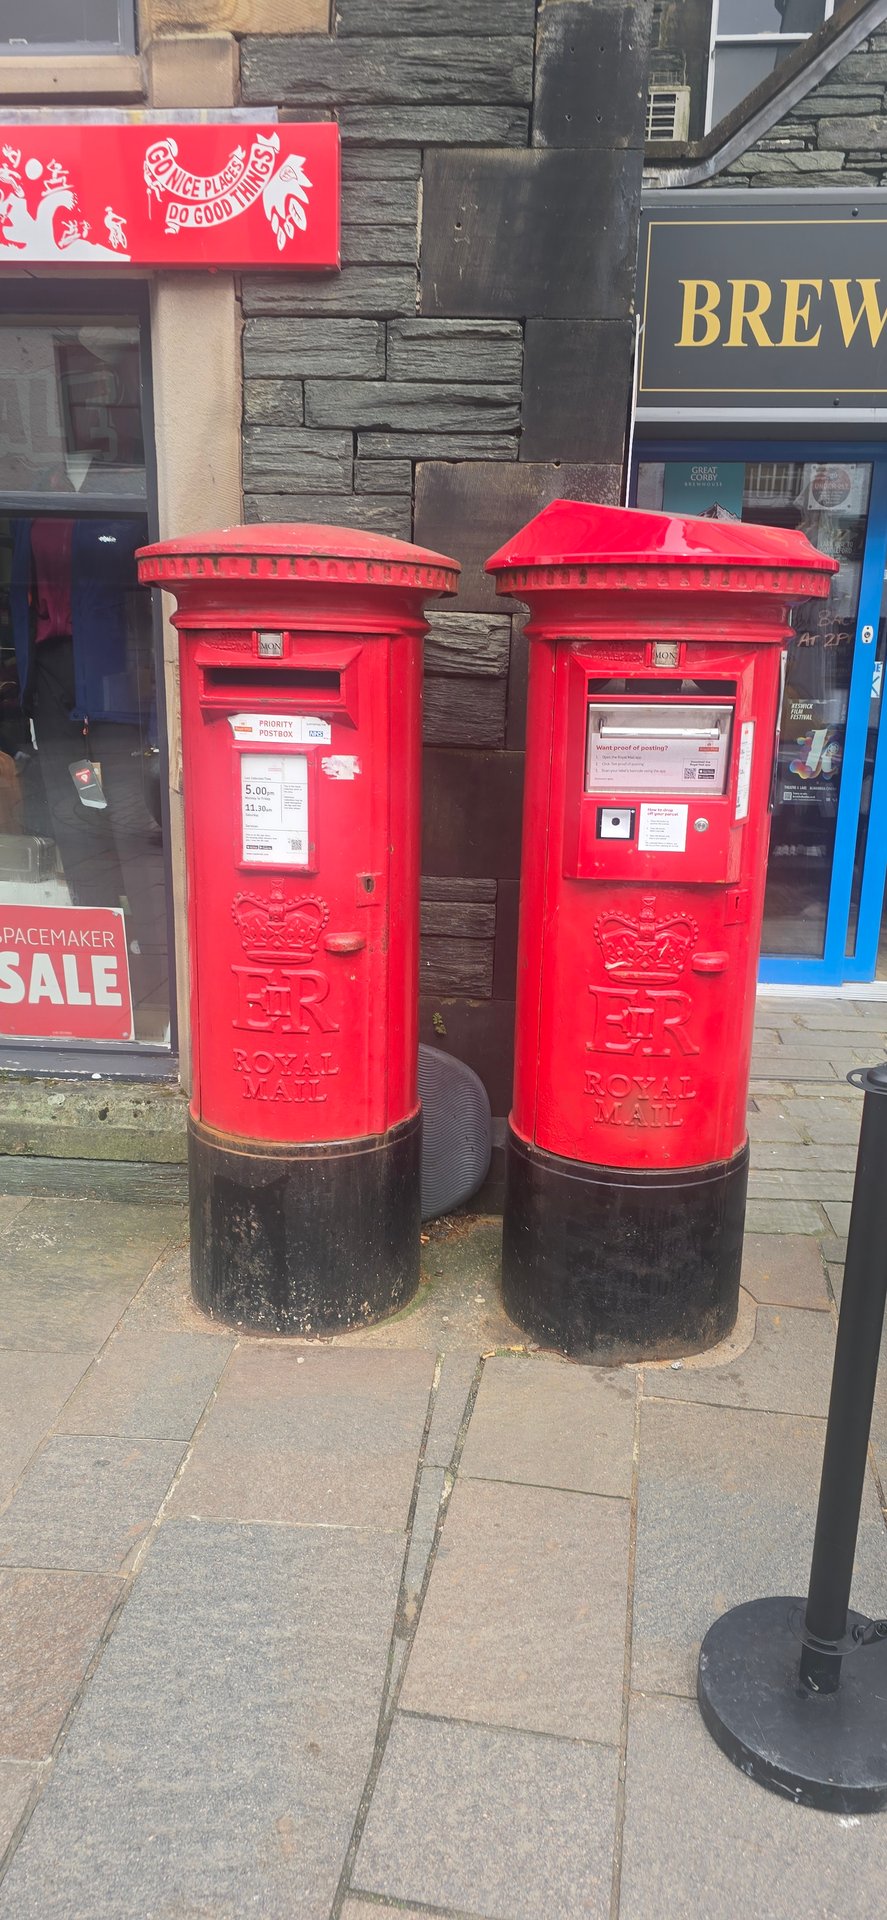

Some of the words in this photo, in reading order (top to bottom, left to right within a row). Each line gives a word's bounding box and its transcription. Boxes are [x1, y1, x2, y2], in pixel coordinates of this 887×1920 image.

[148, 146, 173, 176] GO
[165, 167, 201, 197] NICE
[204, 160, 242, 198] PLACES
[169, 204, 189, 223] DO
[194, 198, 233, 224] GOOD
[230, 148, 273, 208] THINGS
[674, 278, 887, 348] BREW
[690, 473, 718, 481] CORBY
[691, 466, 718, 474] GREAT
[817, 609, 854, 627] BAC
[260, 641, 281, 650] MON
[655, 652, 676, 660] MON
[259, 719, 293, 728] PRIORITY
[259, 729, 293, 738] POSTBOX
[0, 927, 115, 948] PACEMAKER
[0, 951, 122, 1007] SALE
[232, 1048, 339, 1077] ROYAL
[242, 1076, 328, 1103] MAIL
[584, 1070, 697, 1100] ROYAL
[593, 1099, 684, 1128] MAIL
